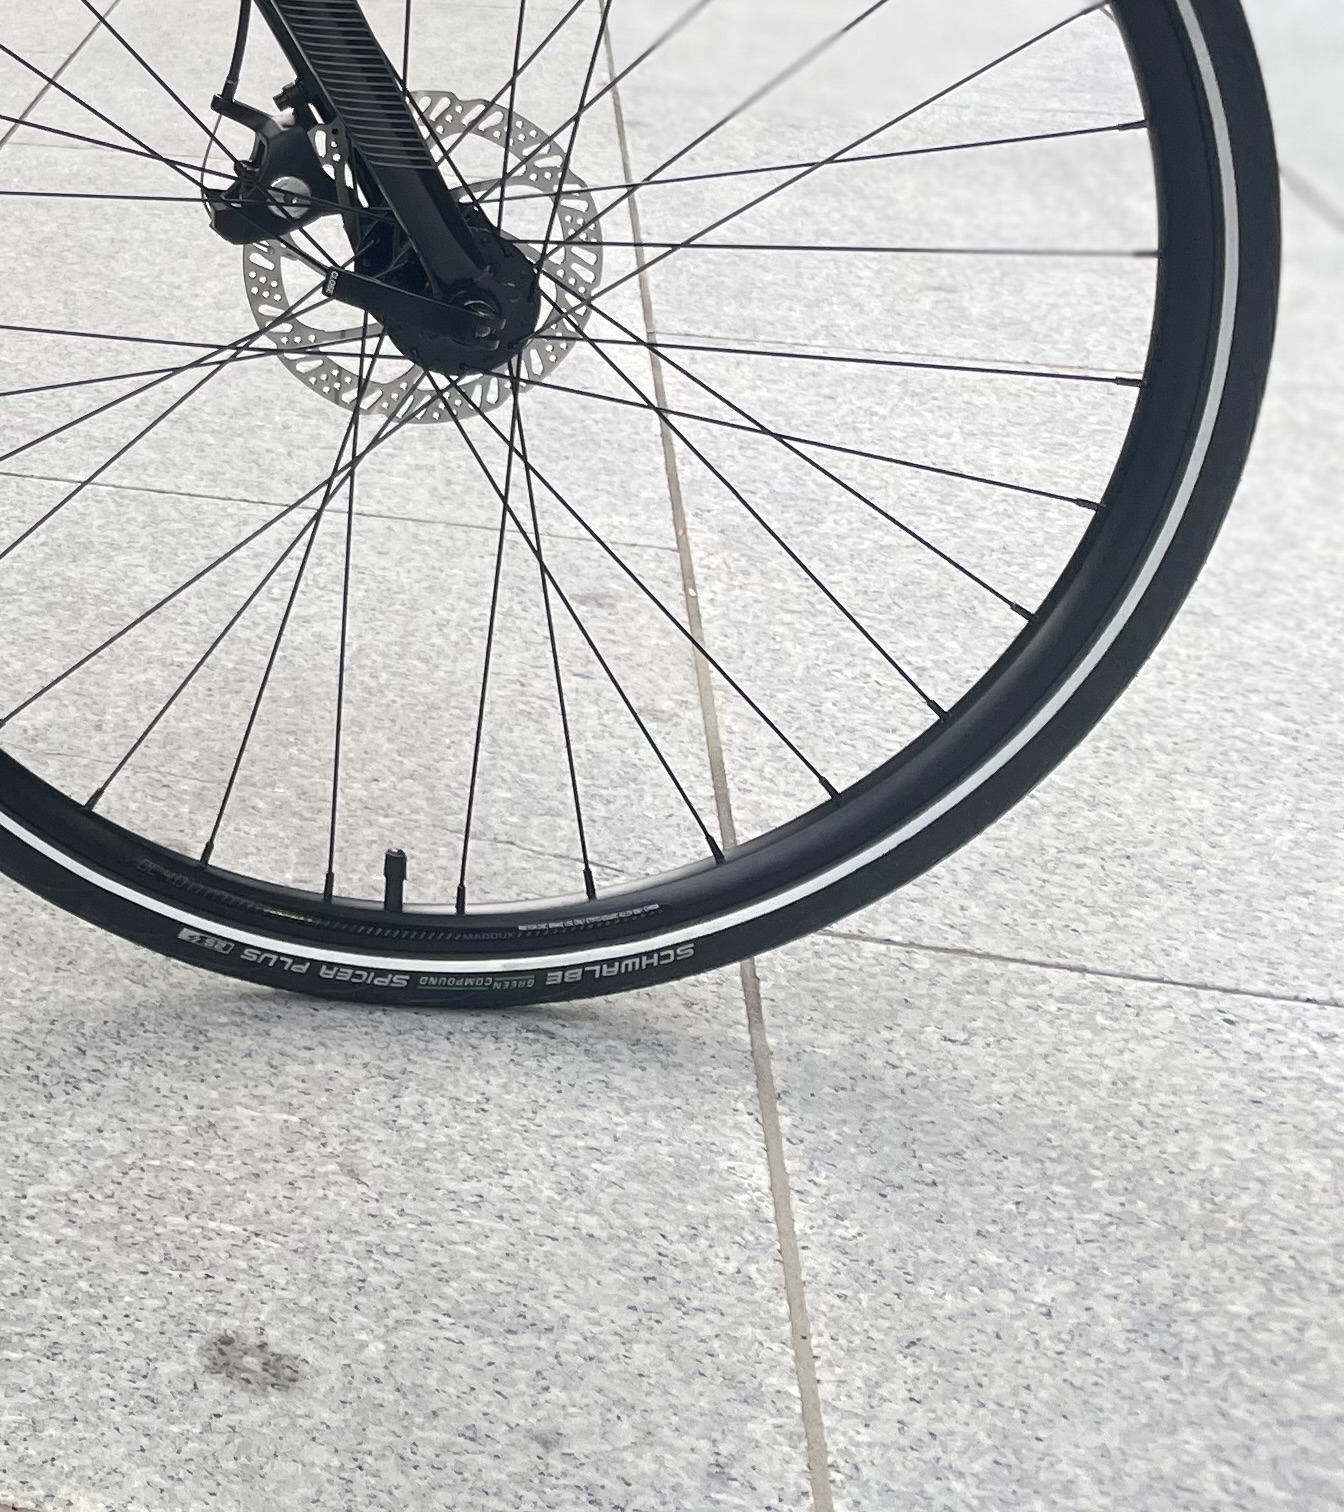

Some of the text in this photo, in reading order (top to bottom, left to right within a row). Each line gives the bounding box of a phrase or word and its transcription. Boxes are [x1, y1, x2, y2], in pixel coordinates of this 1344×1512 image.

[240, 947, 311, 975] PLUS
[544, 942, 695, 986] SCHWALBE
[319, 964, 411, 988] SPICER
[418, 975, 493, 987] COMPOUND
[492, 978, 535, 990] GREEN
